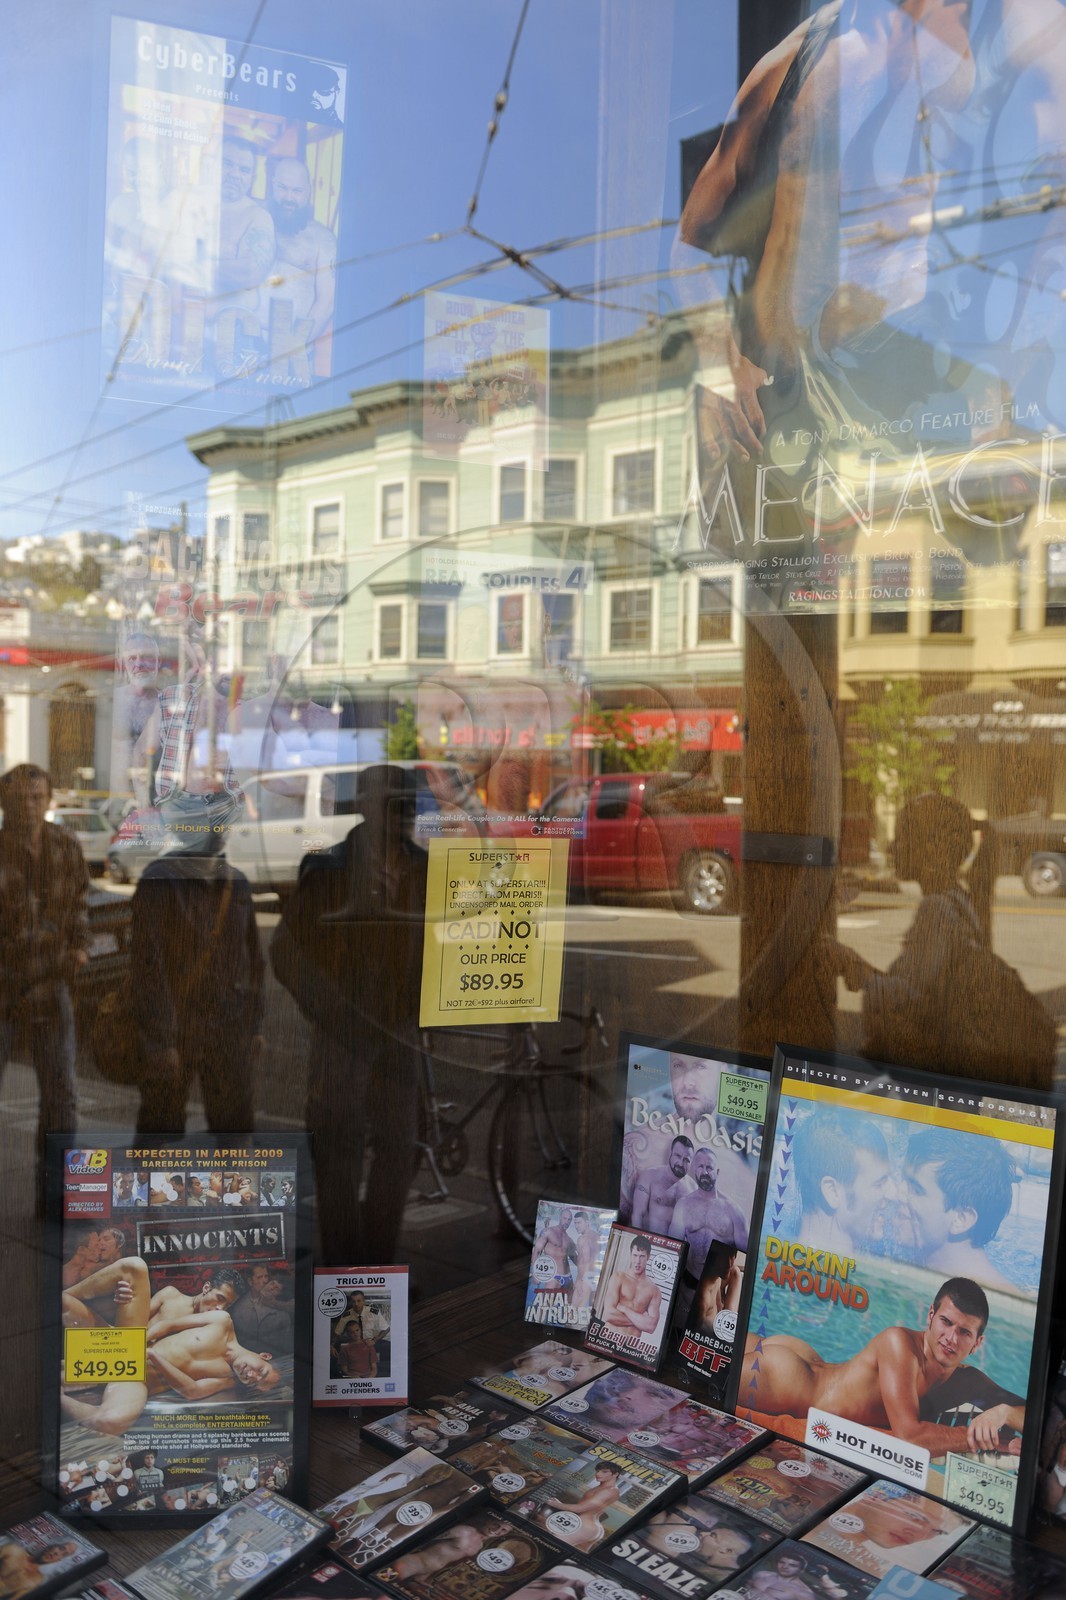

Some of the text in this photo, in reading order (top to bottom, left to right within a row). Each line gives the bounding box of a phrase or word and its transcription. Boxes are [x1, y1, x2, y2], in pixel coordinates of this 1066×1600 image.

[138, 35, 297, 92] CyberBears
[196, 84, 239, 102] Presents
[147, 125, 209, 145] Hours of Action
[503, 330, 525, 346] THE
[776, 401, 1040, 448] A TONY DIMARCO FEATURE FILM
[671, 430, 1066, 552] MENACE
[733, 558, 768, 569] RAGING
[772, 555, 819, 567] STALLION
[884, 550, 923, 560] BRUNO
[929, 547, 963, 558] BOND
[425, 569, 469, 587] REAL
[480, 571, 560, 593] COUPLES
[565, 566, 588, 589] 4
[154, 582, 313, 624] Bears
[789, 587, 925, 602] RAGINGSTALLION.COM
[120, 822, 160, 833] Almost
[175, 822, 210, 833] Hours
[214, 822, 224, 833] of
[468, 815, 495, 823] Couples
[552, 815, 584, 823] Cameras!
[119, 839, 144, 847] French
[146, 839, 184, 847] Connection
[450, 880, 546, 888] ONLY AT SUPERSTAR!!!
[452, 891, 542, 900] DIRECT FROM PARIS!!
[447, 921, 544, 940] CADINOT
[460, 953, 526, 965] OUR PRICE
[460, 973, 524, 992] $89.95
[787, 1065, 1049, 1120] DIRECTED BY STEVEN SCARBOROUGH
[722, 1106, 734, 1115] DVD
[727, 1095, 759, 1111] $49.95
[631, 1097, 763, 1157] Bear Oasis
[125, 1149, 283, 1158] EXPECTED IN APRIL 2009
[68, 1164, 104, 1175] Video
[143, 1227, 278, 1254] INNOCENTS
[653, 1237, 682, 1250] SET MEN
[761, 1261, 869, 1310] AROUND
[589, 1323, 600, 1335] 5
[599, 1326, 627, 1347] Easy
[627, 1334, 658, 1356] Ways
[596, 1338, 611, 1348] FUCK
[616, 1346, 642, 1359] STRAIGHT
[694, 1332, 734, 1354] BAREBACK
[679, 1337, 731, 1373] BFF
[73, 1360, 137, 1378] $49.95
[457, 1401, 485, 1415] ANAL
[514, 1391, 544, 1406] FUCK
[442, 1406, 476, 1422] ABYSS
[544, 1409, 612, 1441] HIGH TOPS
[835, 1430, 868, 1450] HOT
[870, 1445, 924, 1474] HOUSE
[900, 1468, 923, 1479] .COM
[959, 1486, 1005, 1514] $49.95
[611, 1539, 709, 1597] SLEAZE
